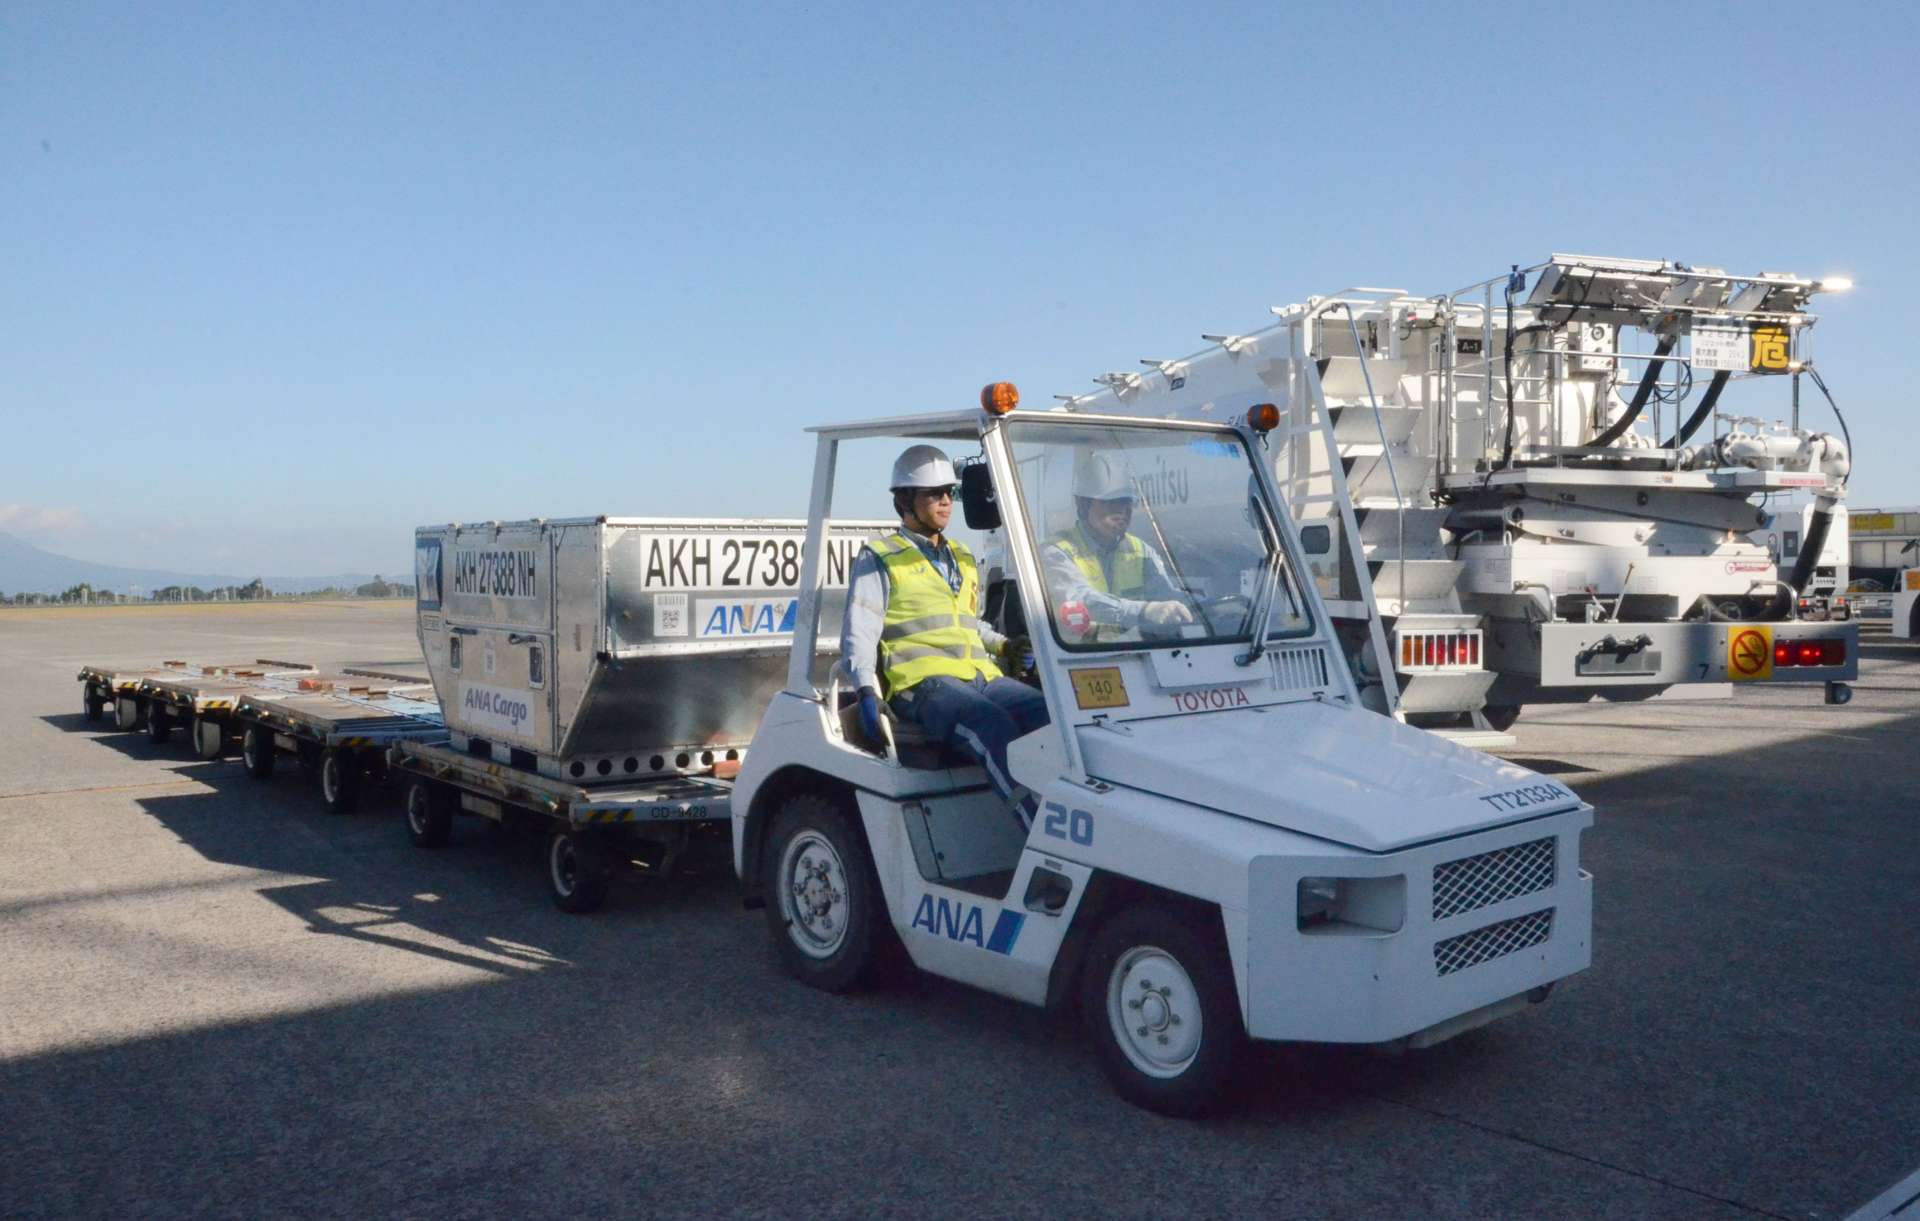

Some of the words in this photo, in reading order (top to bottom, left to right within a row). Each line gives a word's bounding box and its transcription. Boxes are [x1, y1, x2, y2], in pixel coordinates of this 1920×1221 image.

[1752, 327, 1789, 369] 危
[1138, 455, 1189, 505] mitsu
[455, 551, 476, 593] AKH
[479, 551, 515, 597] 27388
[518, 551, 536, 597] NH
[645, 538, 712, 587] AKH
[722, 538, 807, 587] 2738
[704, 603, 775, 635] ANA
[465, 687, 491, 712] ANA
[493, 693, 527, 726] Cargo
[1088, 680, 1113, 697] 140
[1170, 688, 1249, 712] TOYOTA
[1479, 783, 1570, 811] TT2133A
[1045, 801, 1094, 847] 20
[912, 893, 985, 948] ANA
